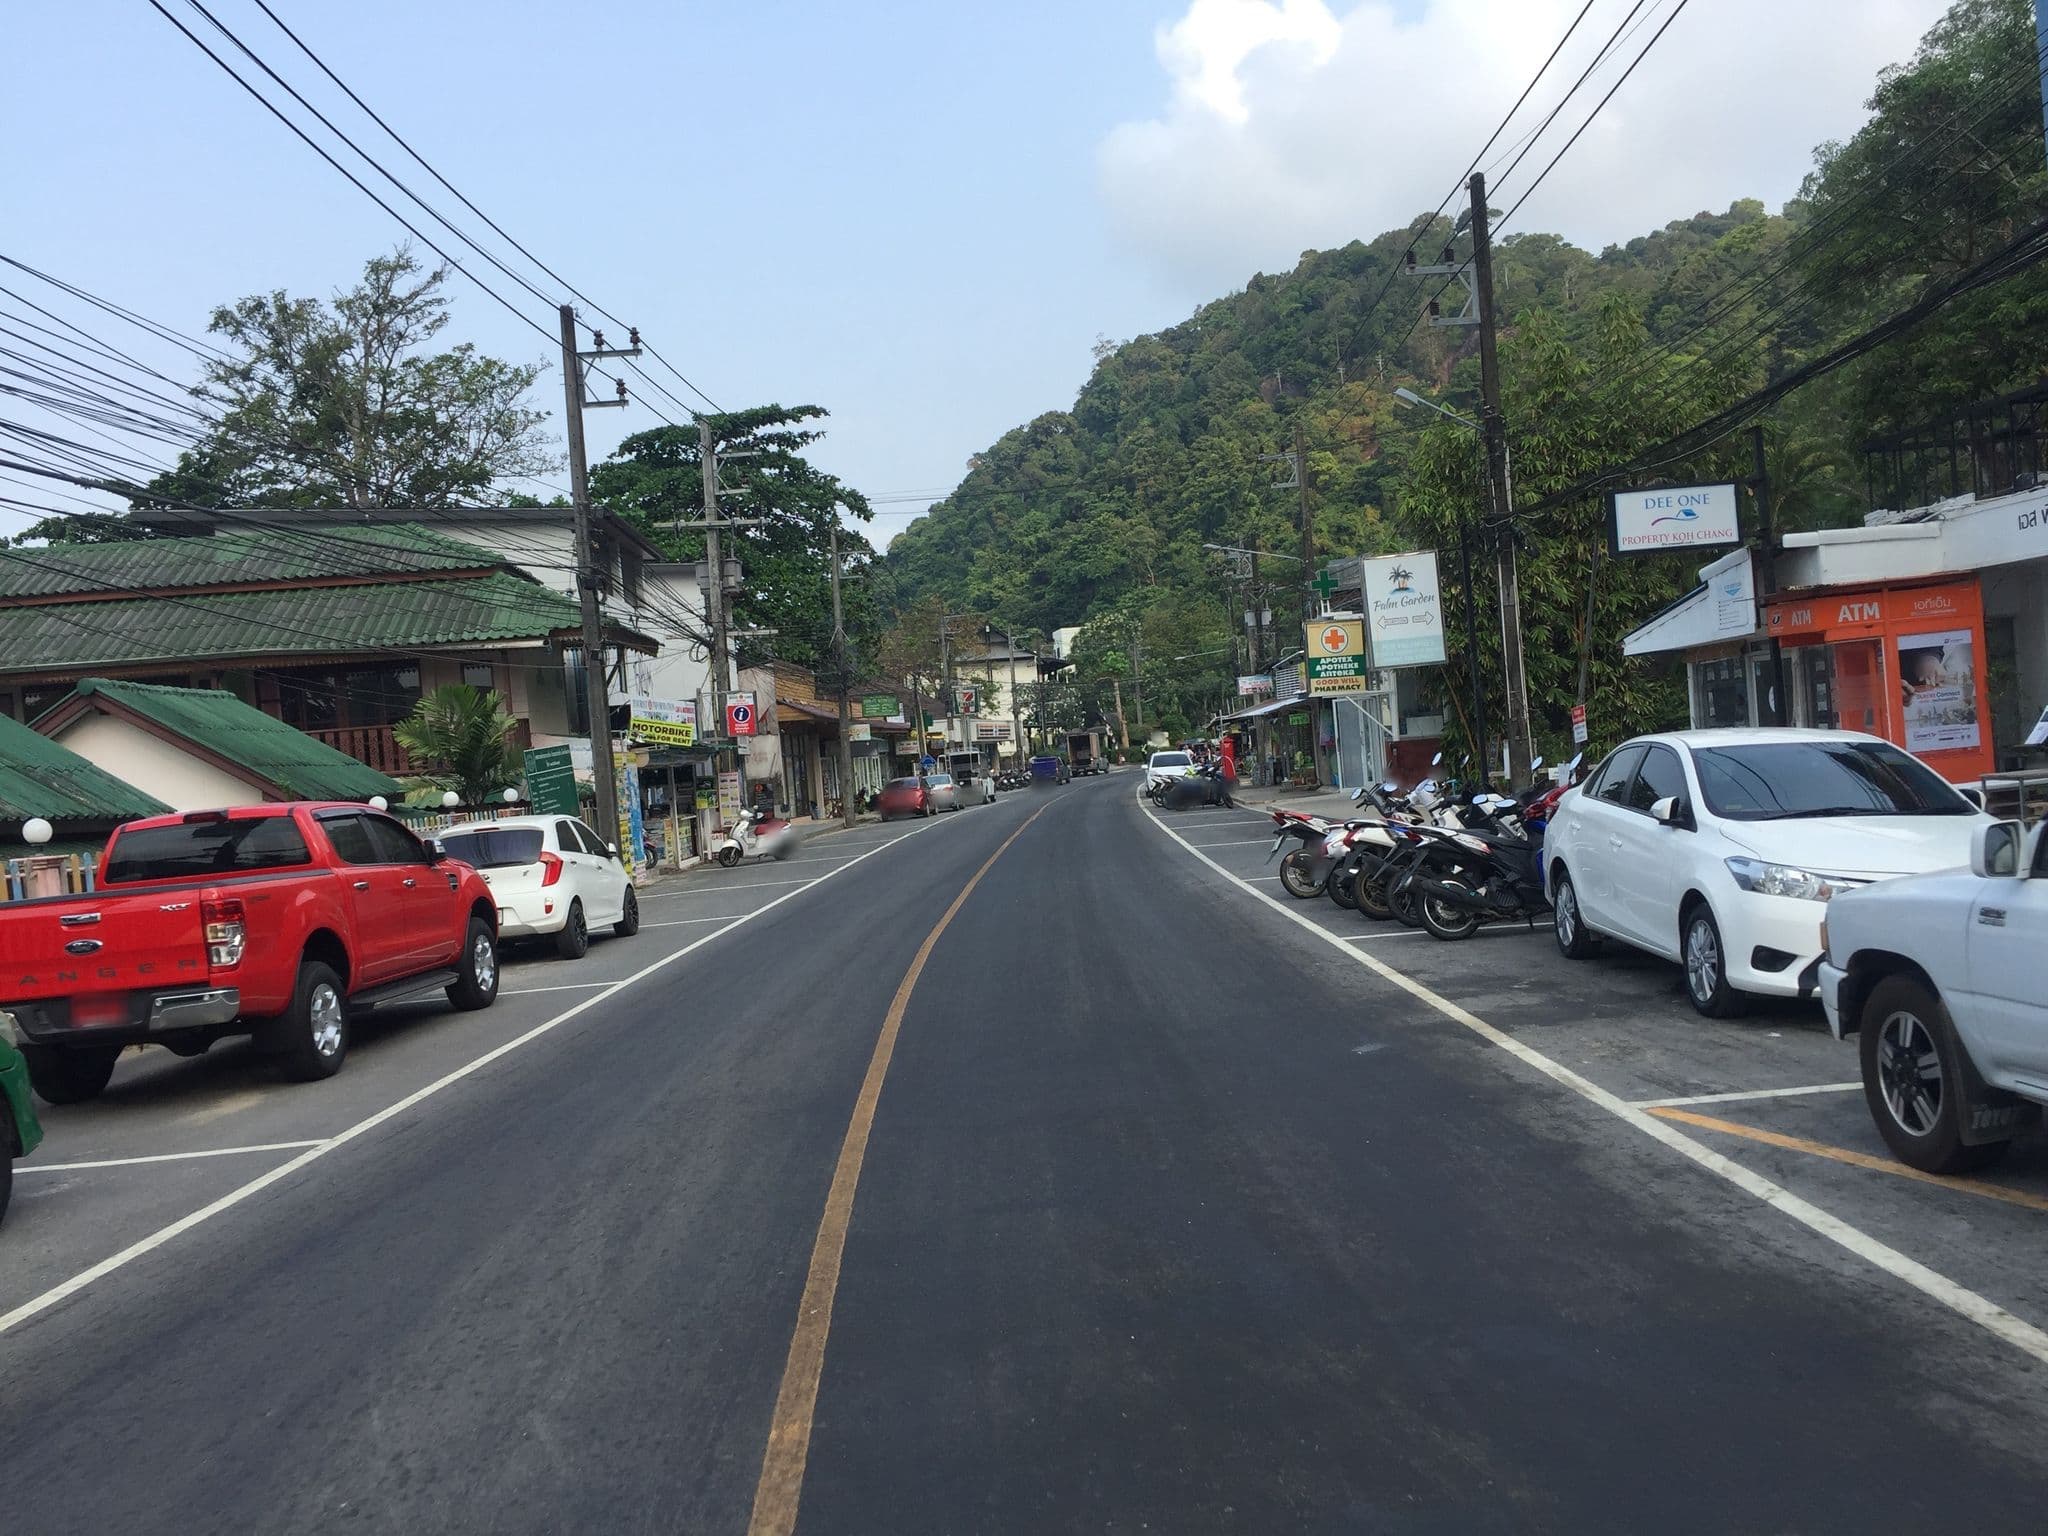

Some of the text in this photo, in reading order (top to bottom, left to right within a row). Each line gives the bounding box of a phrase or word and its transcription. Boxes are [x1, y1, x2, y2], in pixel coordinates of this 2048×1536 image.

[1645, 493, 1711, 509] DEE ONE
[1622, 533, 1670, 545] PROPERTY
[1672, 532, 1694, 542] KOH
[1696, 528, 1733, 540] CHANG
[1373, 592, 1435, 612] Palm Garden
[1791, 609, 1811, 626] ATM
[1838, 601, 1880, 622] ATM
[1315, 662, 1359, 671] APOTHEKE
[1320, 656, 1353, 664] APOTEX
[1314, 684, 1361, 692] PHARMACY
[1315, 678, 1339, 686] GOOD
[1936, 690, 1960, 698] Connect
[632, 723, 691, 737] MOTORBIKE
[18, 959, 198, 985] ANGER
